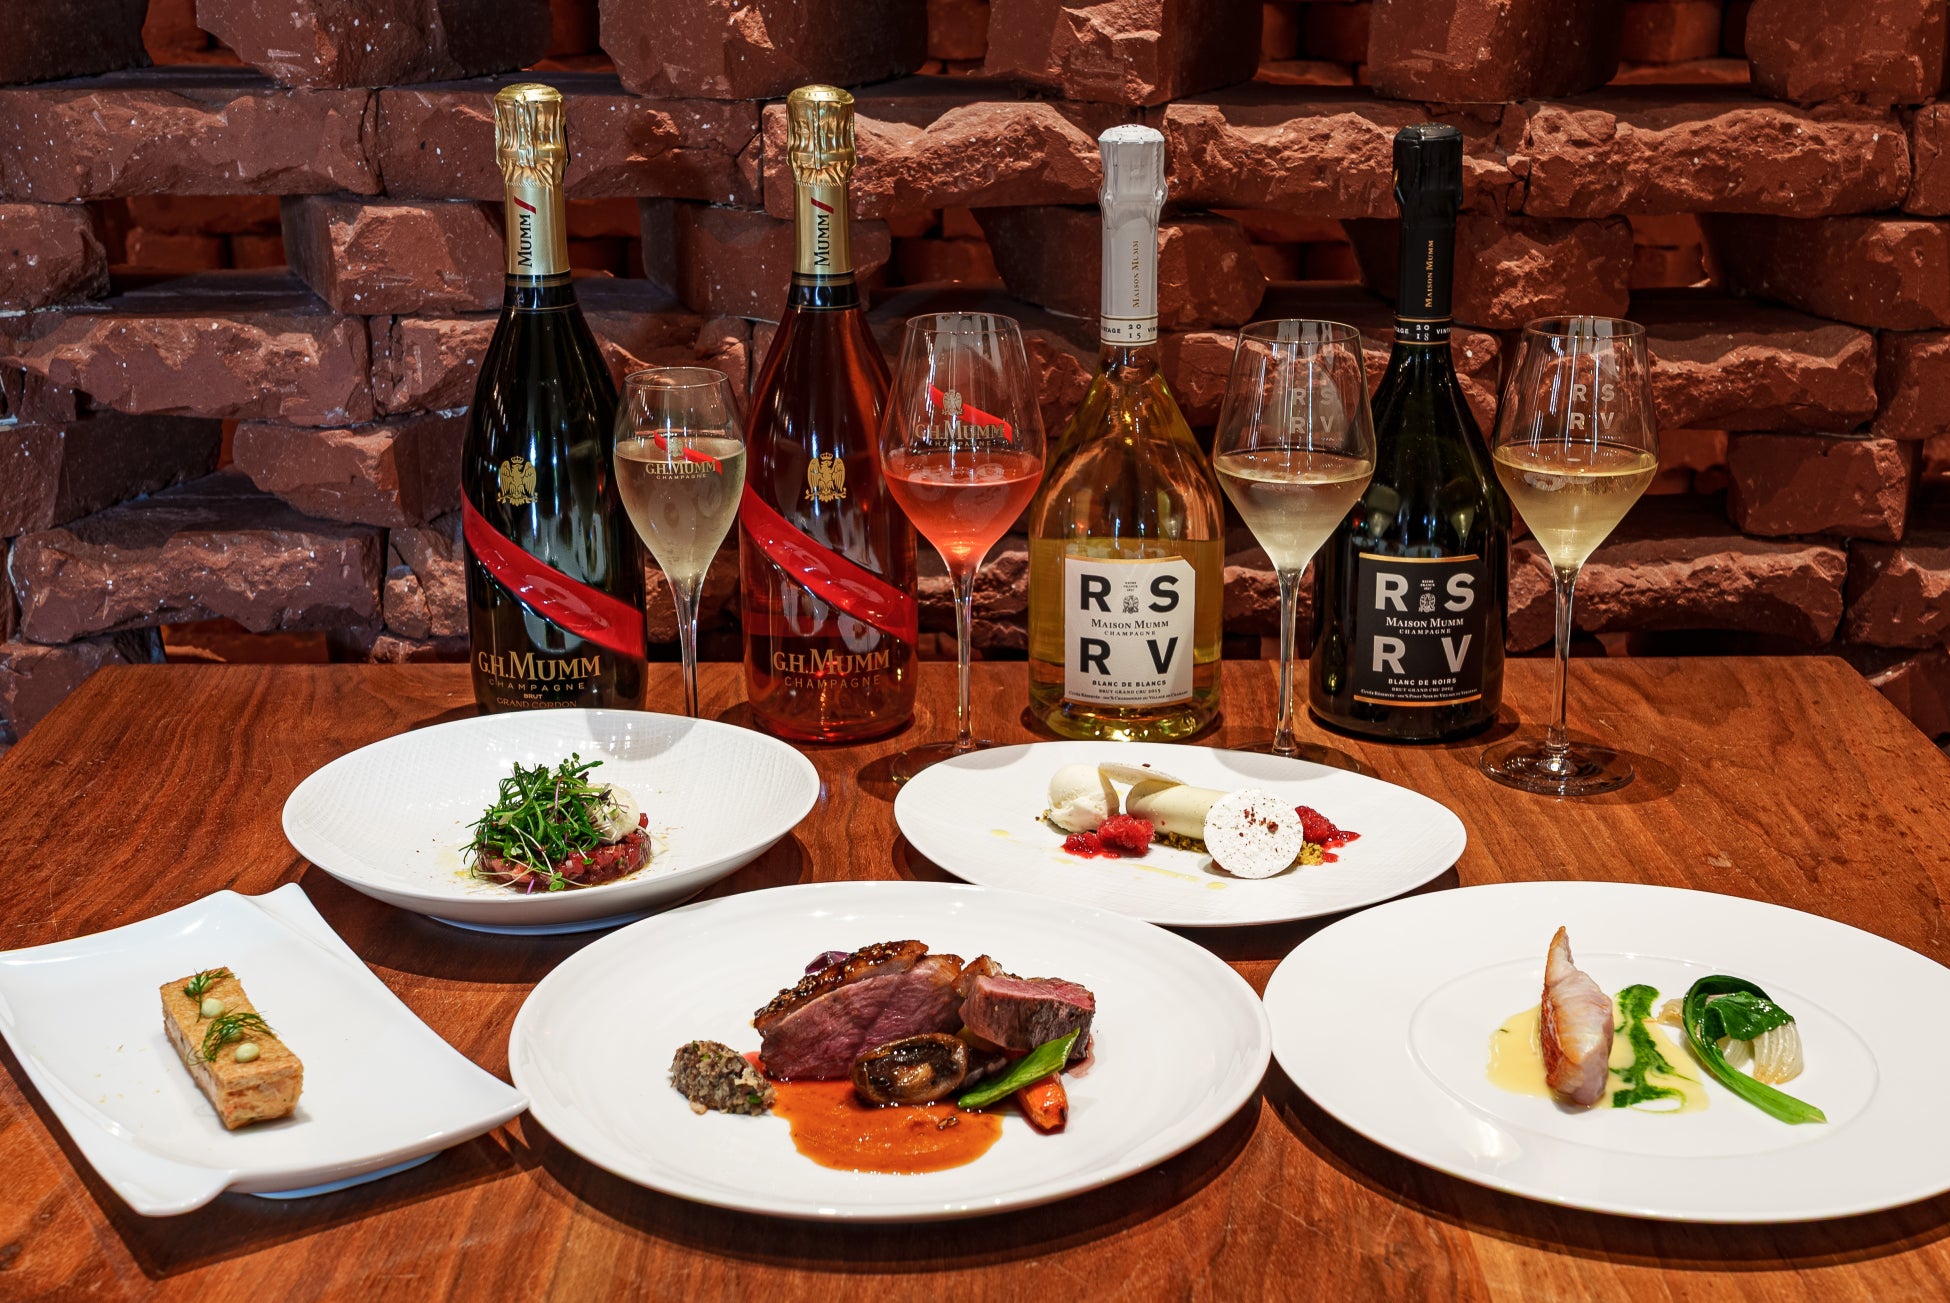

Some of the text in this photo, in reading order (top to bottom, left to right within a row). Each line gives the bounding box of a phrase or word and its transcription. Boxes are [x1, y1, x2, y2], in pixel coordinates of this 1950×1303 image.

[518, 214, 532, 267] MUMM
[814, 213, 830, 266] MUMM
[1131, 240, 1140, 308] MAISON MUMM
[1425, 240, 1434, 308] MAISON MUMM
[1573, 383, 1615, 402] R S
[1320, 415, 1335, 433] V
[1570, 412, 1615, 430] R V
[1080, 573, 1180, 613] R S
[1375, 572, 1475, 612] R S
[1091, 618, 1169, 629] MAISON MUMM
[1386, 616, 1464, 628] MAISON MUMM
[1080, 636, 1179, 675] R V
[1372, 634, 1473, 674] R V
[489, 678, 585, 692] CHAMPAGNE
[784, 674, 881, 689] CHAMPAGNE
[1388, 678, 1415, 686] BLANC
[1432, 677, 1457, 686] NOIRS
[496, 697, 577, 708] GRAND CORDON
